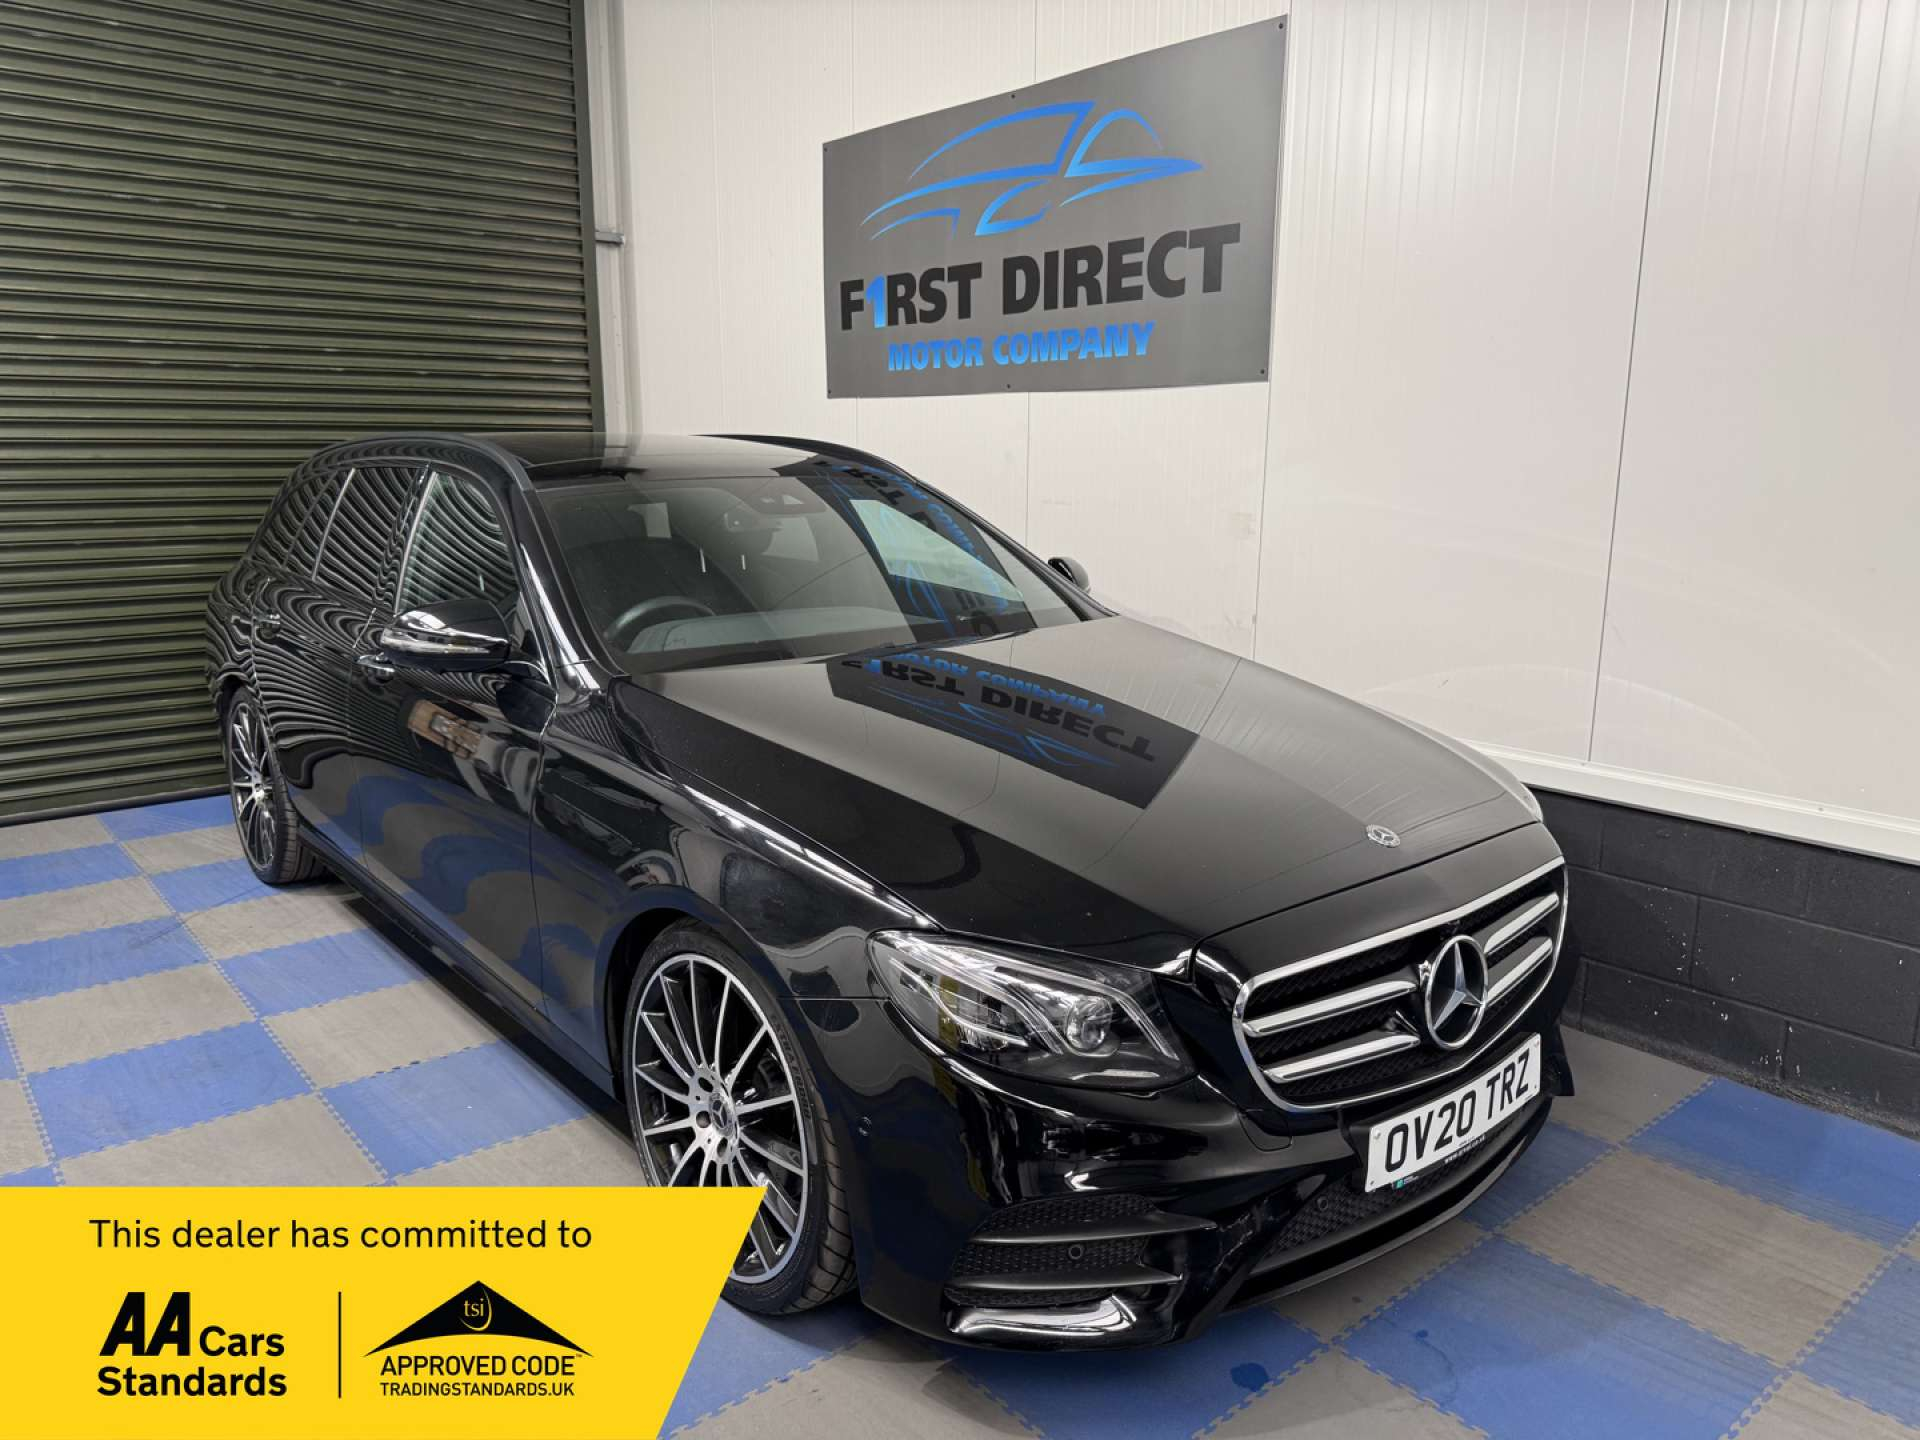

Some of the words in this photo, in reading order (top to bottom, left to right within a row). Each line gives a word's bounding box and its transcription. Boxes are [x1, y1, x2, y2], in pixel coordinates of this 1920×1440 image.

[840, 262, 983, 331] F1RST
[1002, 223, 1241, 315] DIRECT
[888, 337, 984, 372] MOTOR
[993, 320, 1156, 365] COMPANY
[1385, 1089, 1477, 1173] OV20
[1486, 1048, 1530, 1121] TRZ
